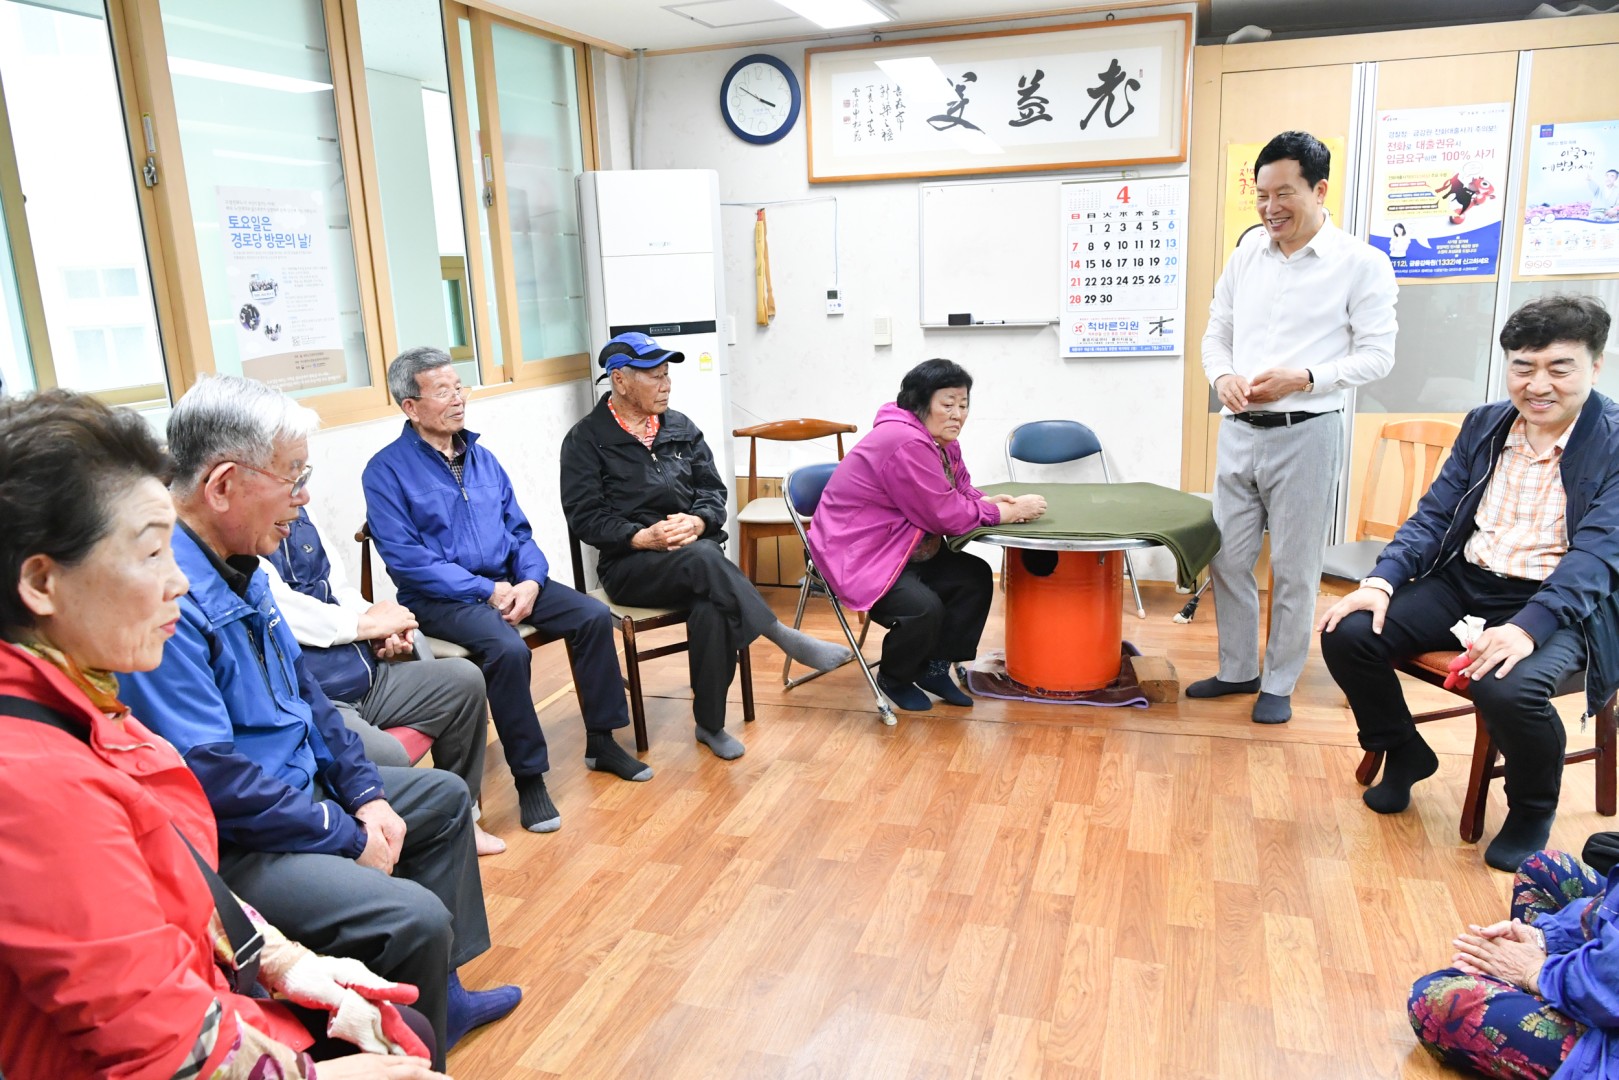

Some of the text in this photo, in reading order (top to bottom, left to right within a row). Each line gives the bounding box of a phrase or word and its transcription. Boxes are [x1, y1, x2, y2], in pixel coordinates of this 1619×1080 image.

[1388, 141, 1411, 152] 전화로
[1387, 149, 1494, 164] 입금요구하면 100% 사기
[1117, 186, 1131, 203] 4
[228, 216, 272, 232] 토요일은
[1089, 221, 1175, 233] 1 2 3 4 5 6
[231, 233, 311, 248] 경로당 방문의 날!
[1072, 239, 1176, 251] 7 8 9 10 11 12 13
[1070, 257, 1177, 269] 14 15 16 17 18 19 20
[1071, 275, 1176, 286] 21 22 23 24 25 26 27
[1070, 294, 1112, 304] 28 29 30
[1088, 321, 1139, 331] 척바른의원
